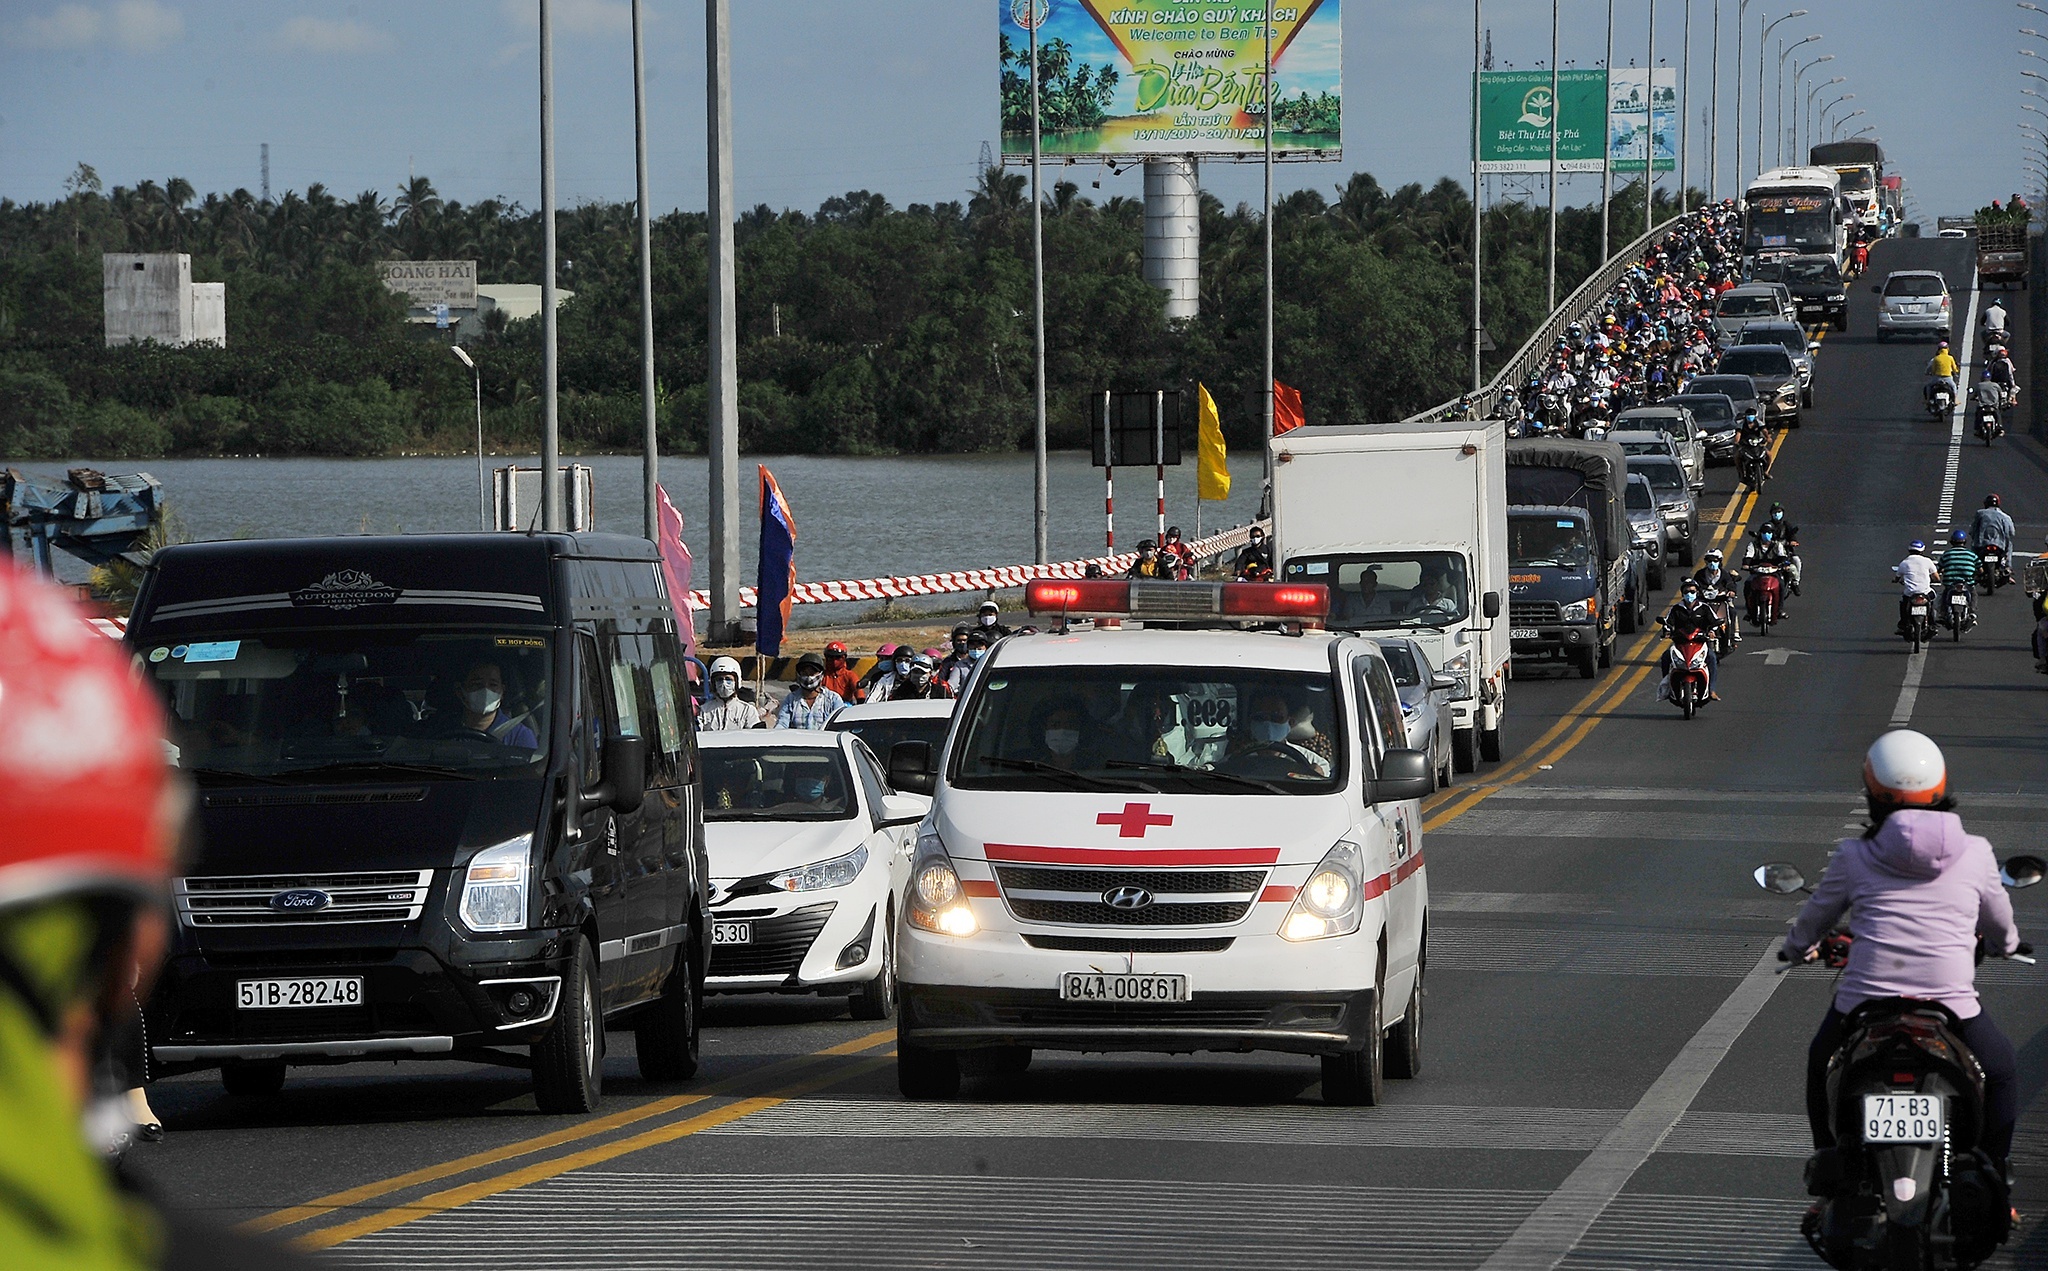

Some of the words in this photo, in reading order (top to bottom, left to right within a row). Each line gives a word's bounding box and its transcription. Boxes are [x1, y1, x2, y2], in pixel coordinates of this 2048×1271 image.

[1109, 8, 1148, 24] KÍNH
[1151, 8, 1200, 24] CHÀO
[1203, 6, 1237, 23] QUÝ
[1129, 27, 1196, 41] Welcome
[1200, 28, 1215, 40] to
[1219, 27, 1249, 41] Ben
[1173, 50, 1204, 59] CHÀO
[1205, 47, 1235, 58] MỪNG
[1174, 112, 1197, 126] LẦN
[1199, 114, 1220, 126] THỨ
[1221, 116, 1232, 125] V
[1134, 129, 1199, 141] 16/11/2019
[1206, 127, 1275, 140] 20/11/201
[1499, 130, 1515, 141] Biệt
[1518, 129, 1535, 141] Thự
[1537, 130, 1561, 142] Hưg
[1564, 129, 1580, 139] Phú
[1482, 163, 1498, 171] 0275
[341, 572, 352, 580] A
[295, 591, 395, 601] AUTOKINGDOM
[284, 893, 317, 907] Ford
[240, 979, 360, 1006] 51B-282.48
[1069, 976, 1180, 1001] 84A-008.61
[1869, 1119, 1938, 1139] 928.09
